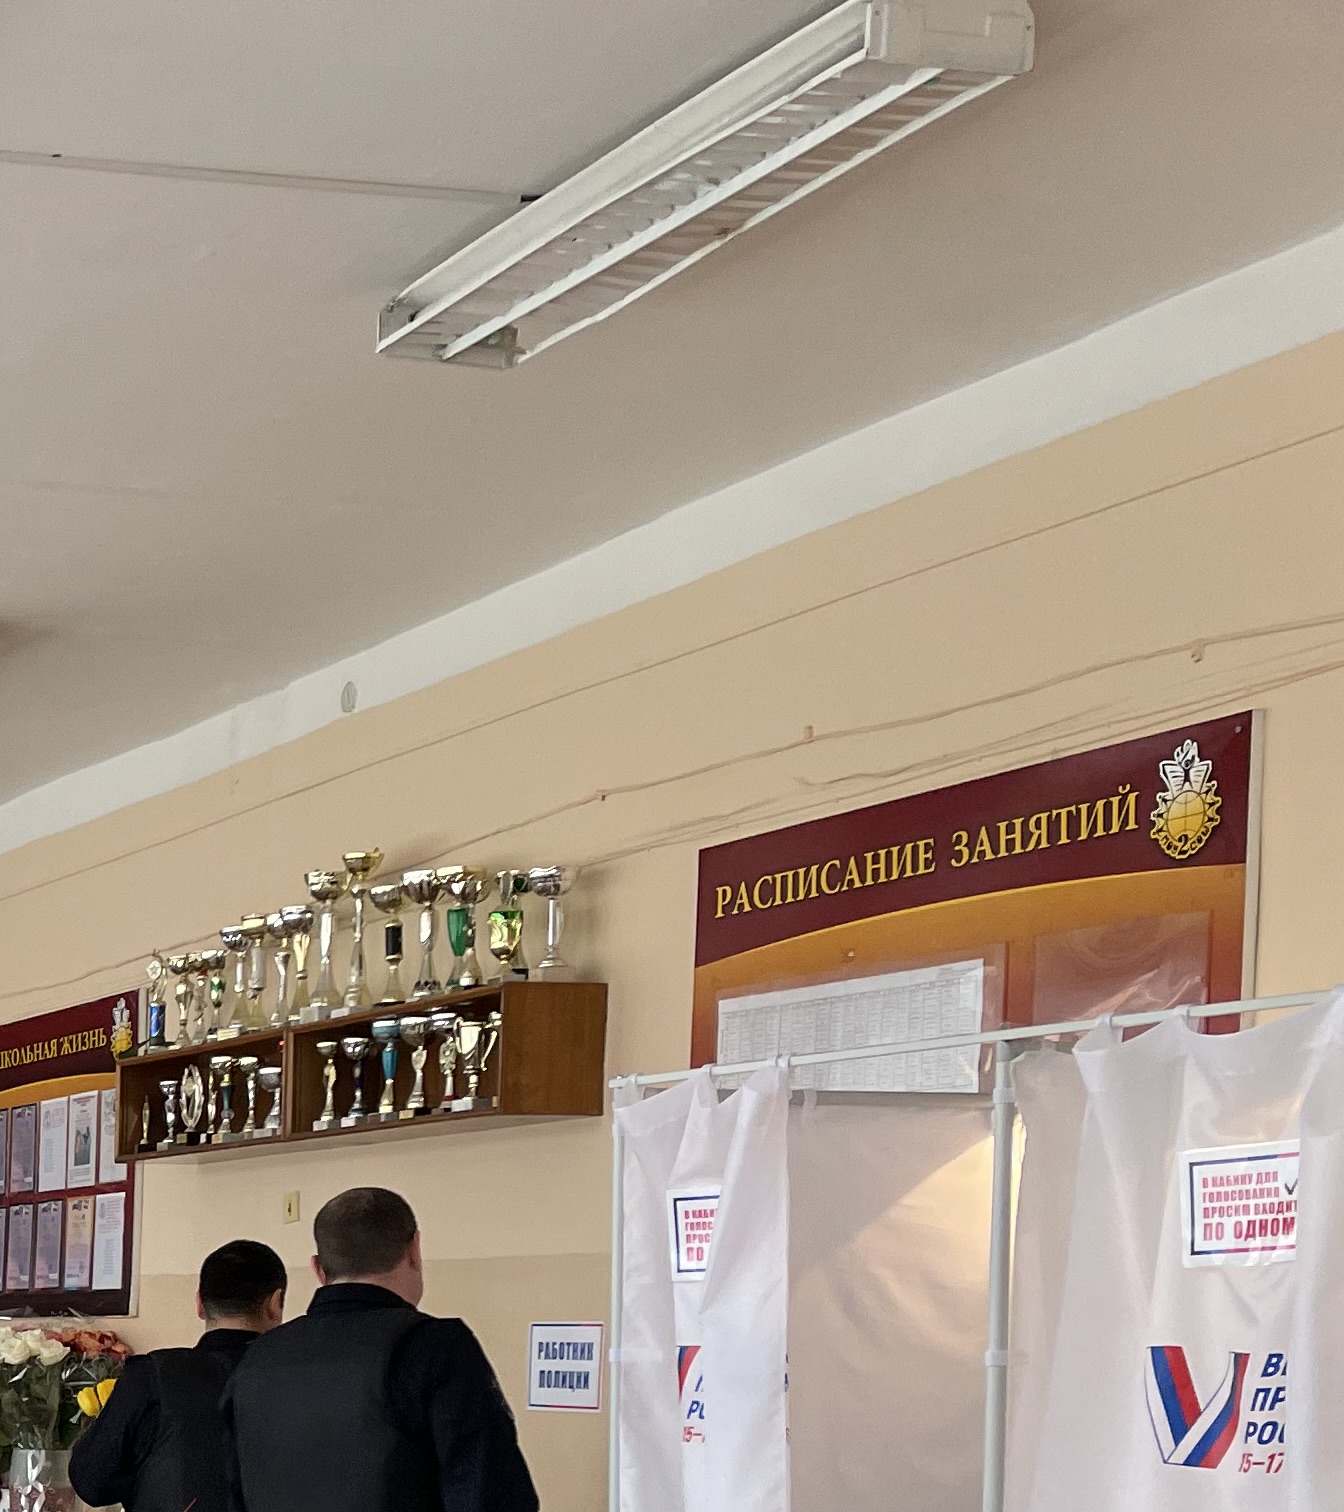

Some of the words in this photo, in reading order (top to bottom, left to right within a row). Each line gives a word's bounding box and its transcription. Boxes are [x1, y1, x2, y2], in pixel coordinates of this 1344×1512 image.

[714, 839, 937, 919] РАСПИСАНИЕ
[950, 784, 1141, 868] ЗАНЯТИЙ
[60, 1027, 107, 1056] ЖИЗНЬ
[1212, 1173, 1253, 1188] КАБИНУ
[1256, 1171, 1279, 1186] ДЛЯ
[1203, 1186, 1280, 1204] ГОЛОСОВАНИЯ
[692, 1209, 715, 1219] КАБИ
[1203, 1203, 1251, 1219] ПРОСИМ
[1254, 1200, 1298, 1216] ВХОДИТ
[1203, 1222, 1224, 1241] ПО
[1233, 1216, 1296, 1242] ОДНОМ
[538, 1342, 594, 1361] РАБОТНИК
[538, 1370, 589, 1392] ПОЛИЦИИ
